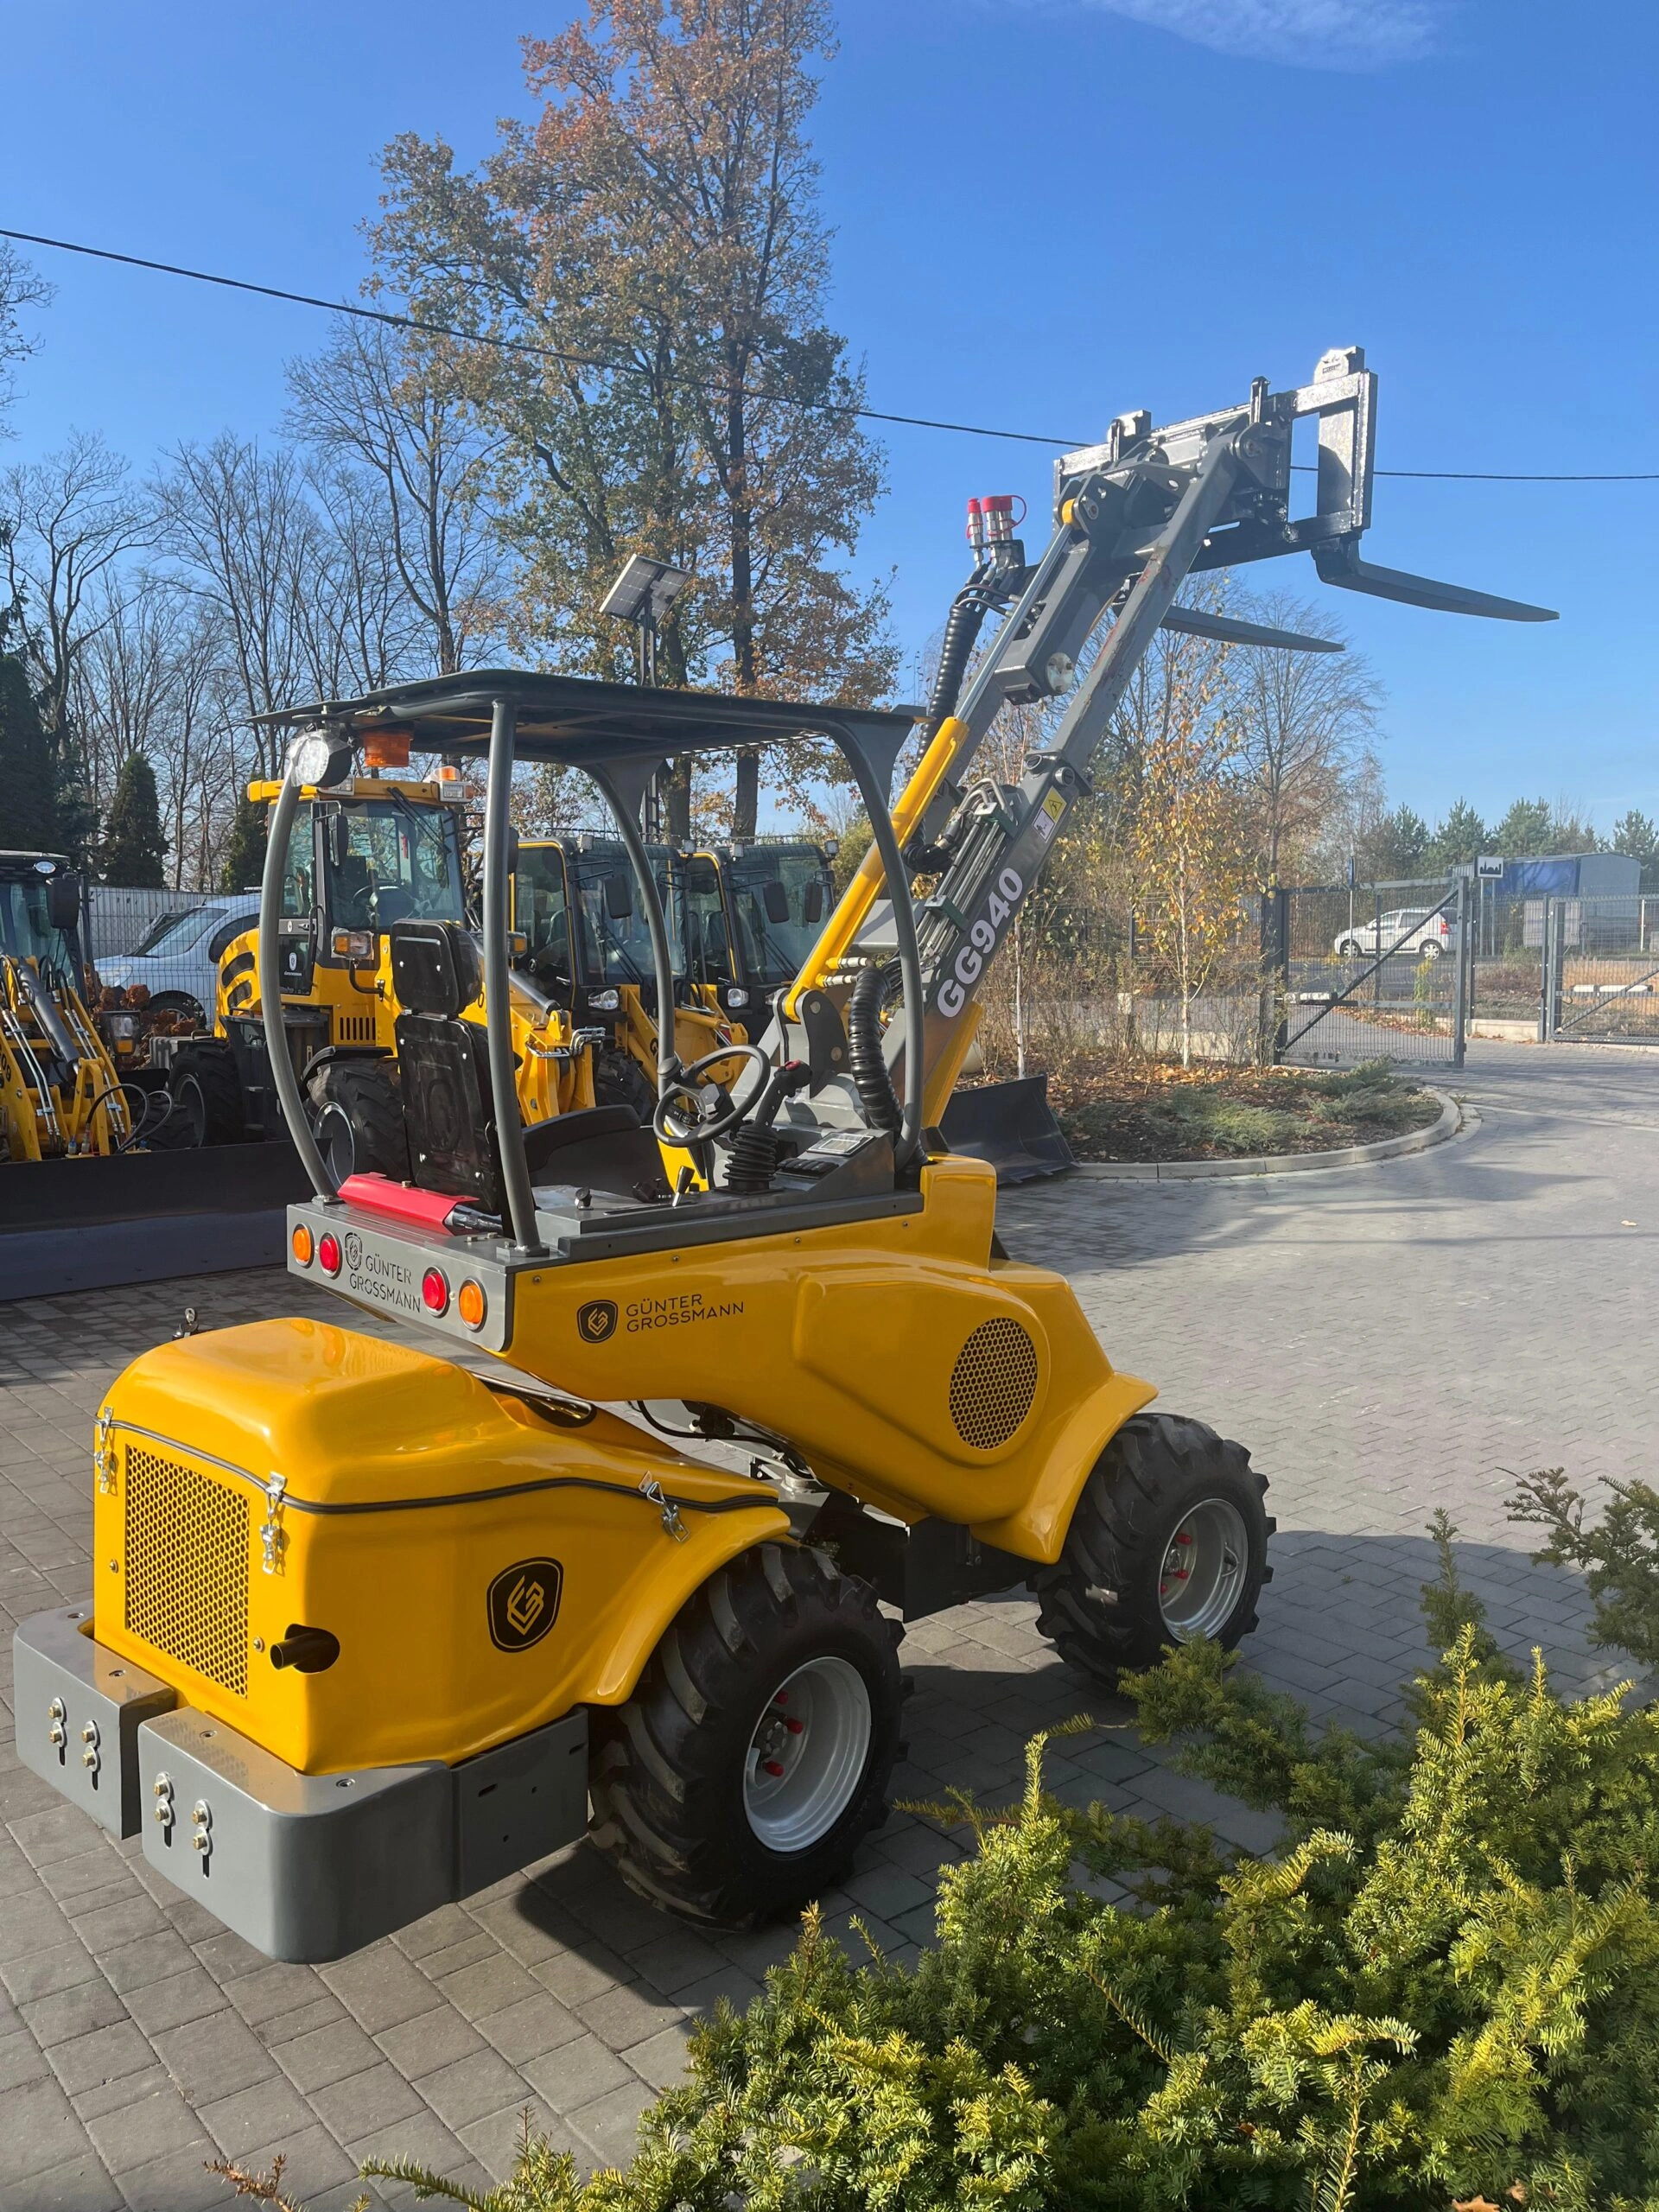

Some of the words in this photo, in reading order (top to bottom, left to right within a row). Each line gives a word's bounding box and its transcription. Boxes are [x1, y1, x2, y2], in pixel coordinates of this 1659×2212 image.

[938, 868, 1023, 1018] GG940
[365, 1253, 412, 1285] GÜNTER
[349, 1273, 421, 1313] GROSSMANN
[626, 1294, 702, 1317] GÜNTER
[626, 1301, 744, 1332] GROSSMANN
